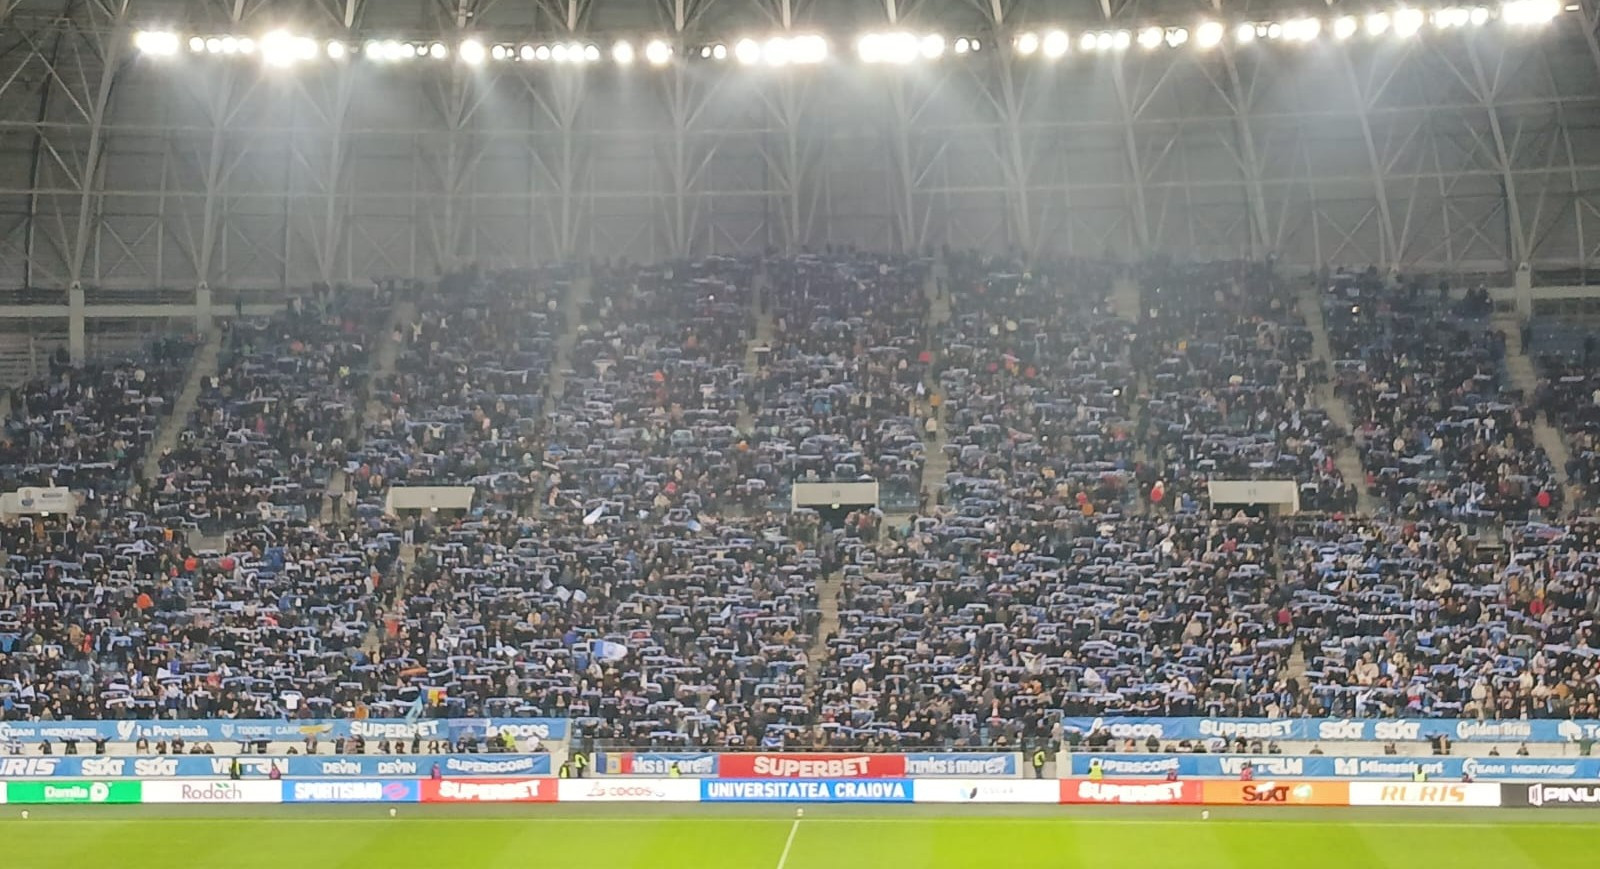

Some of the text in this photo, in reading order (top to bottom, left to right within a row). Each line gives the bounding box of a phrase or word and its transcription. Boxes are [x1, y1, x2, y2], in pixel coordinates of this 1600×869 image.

[153, 725, 208, 736] Provincia
[350, 721, 440, 738] SUPERBET
[1200, 719, 1293, 738] SUPERBET
[322, 758, 361, 774] DEVIN
[378, 758, 416, 774] DEVIN
[446, 757, 534, 773] SUPERSCORE
[753, 756, 870, 778] SUPERBET
[44, 785, 89, 799] Damila
[439, 780, 540, 800] SUPERBET
[707, 781, 906, 798] UNIVERSITATEA CRAIOVA
[1078, 780, 1184, 802] SUPERBET
